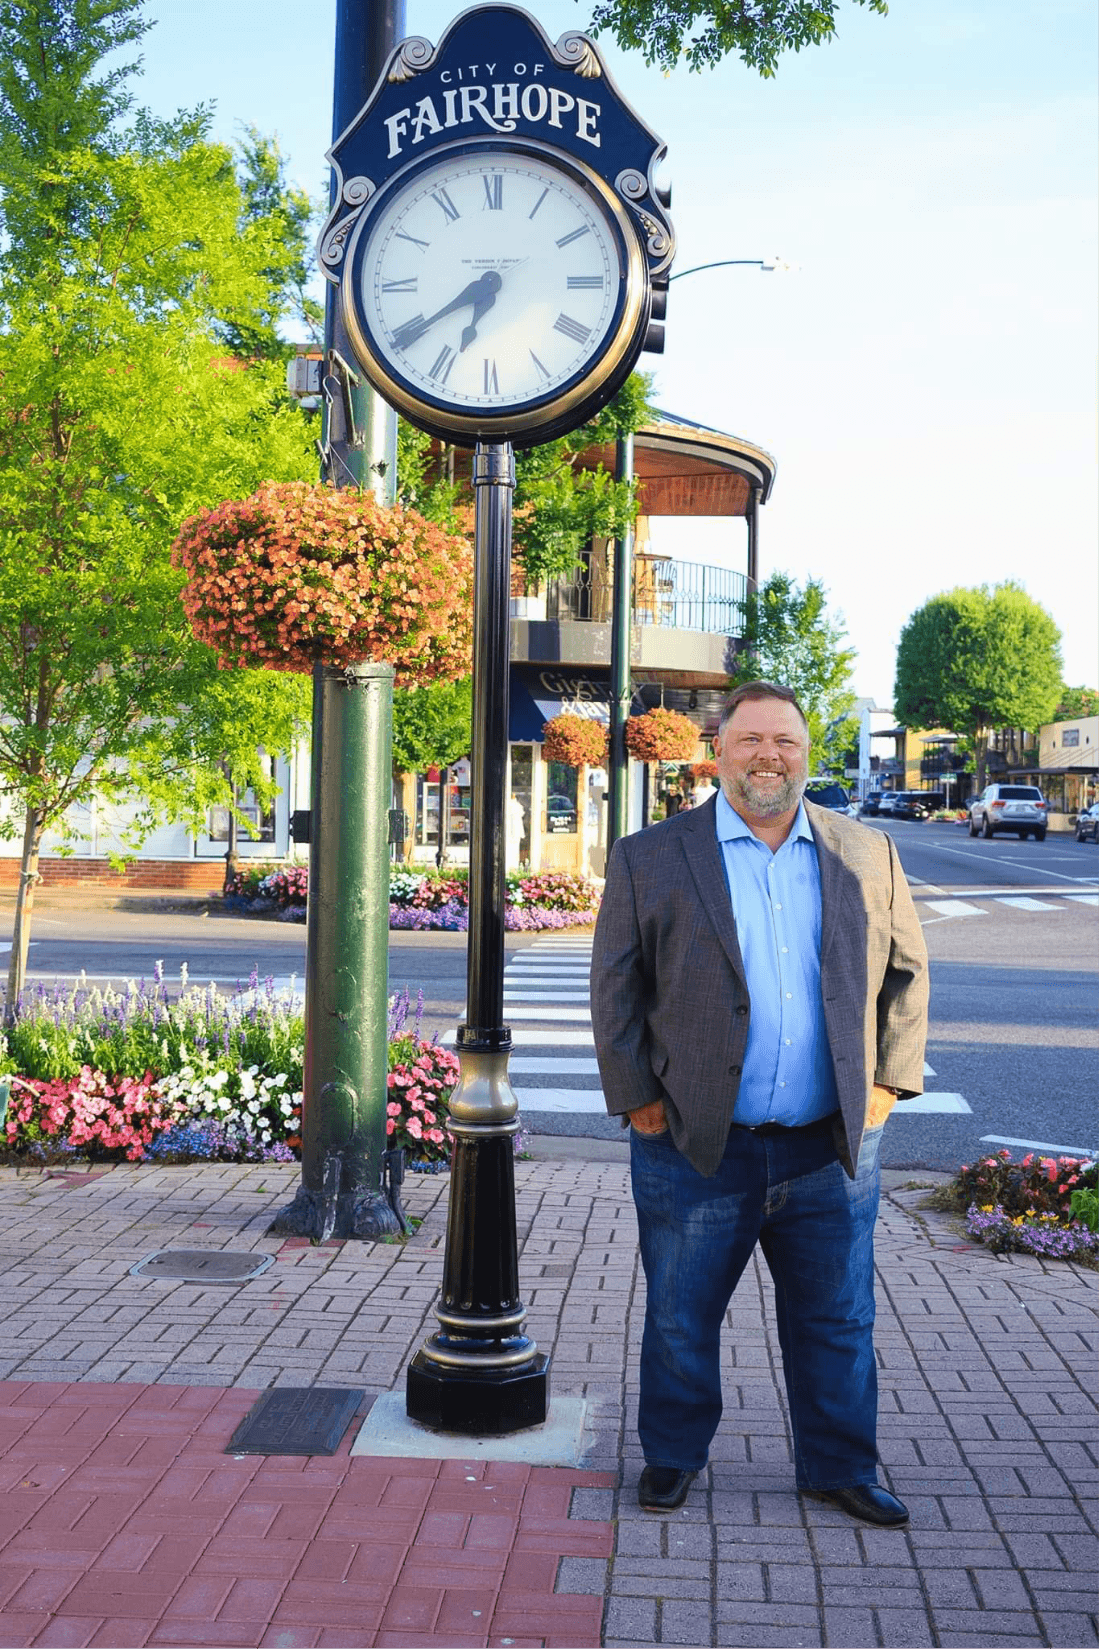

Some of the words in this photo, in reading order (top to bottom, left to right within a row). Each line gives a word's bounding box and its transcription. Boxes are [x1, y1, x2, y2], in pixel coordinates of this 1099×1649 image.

[440, 63, 497, 82] CITY
[513, 62, 545, 76] OF
[383, 83, 601, 159] FAIRHOPE
[482, 174, 503, 211] XII
[566, 275, 604, 290] III
[483, 358, 499, 395] VI
